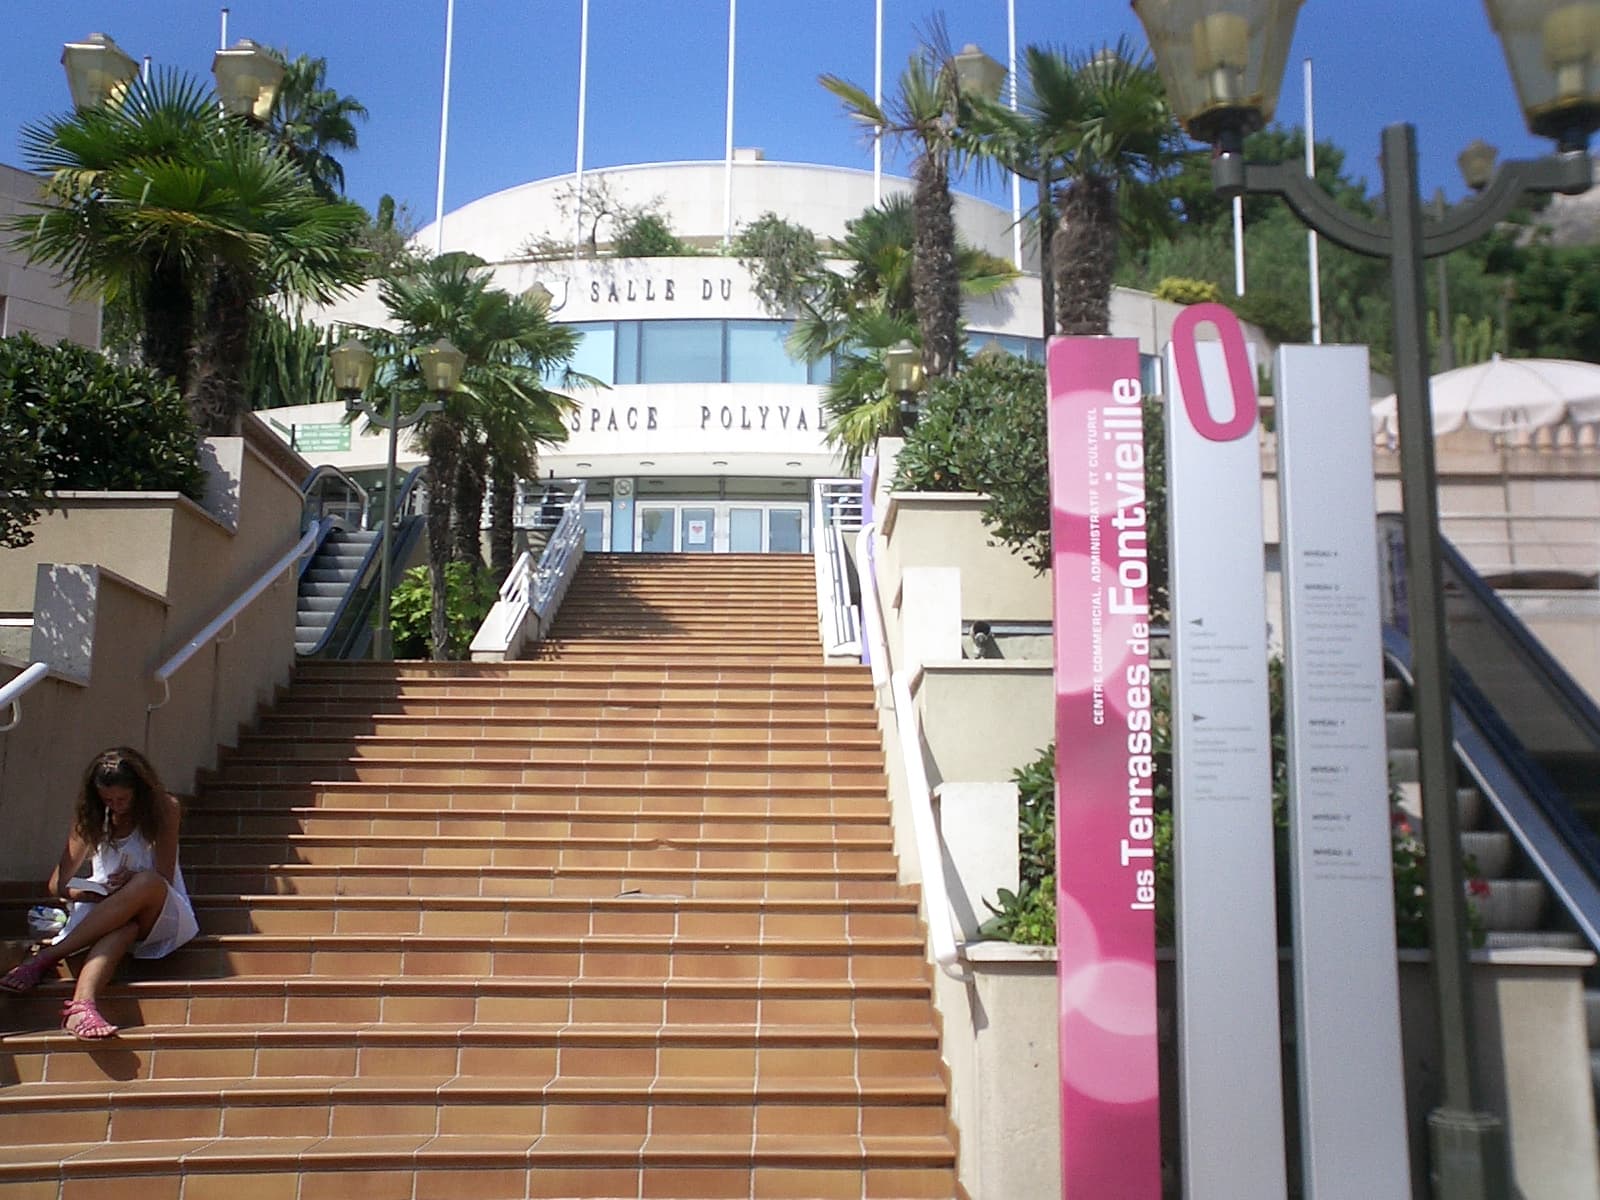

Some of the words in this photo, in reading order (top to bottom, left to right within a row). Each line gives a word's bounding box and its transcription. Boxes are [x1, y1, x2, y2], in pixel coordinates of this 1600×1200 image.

[590, 279, 676, 302] SALLE
[701, 278, 732, 301] DU
[571, 406, 657, 432] SPACE
[700, 405, 828, 431] POLYVAL
[1088, 407, 1099, 467] CULTUREL
[1089, 471, 1099, 485] ET
[1103, 377, 1150, 615] Fontvieille
[1089, 490, 1102, 583] ADMINISTRATIF
[1126, 622, 1150, 655] de
[1093, 676, 1104, 725] CENTRE
[1120, 664, 1155, 867] Terrasses
[1131, 868, 1155, 911] les
